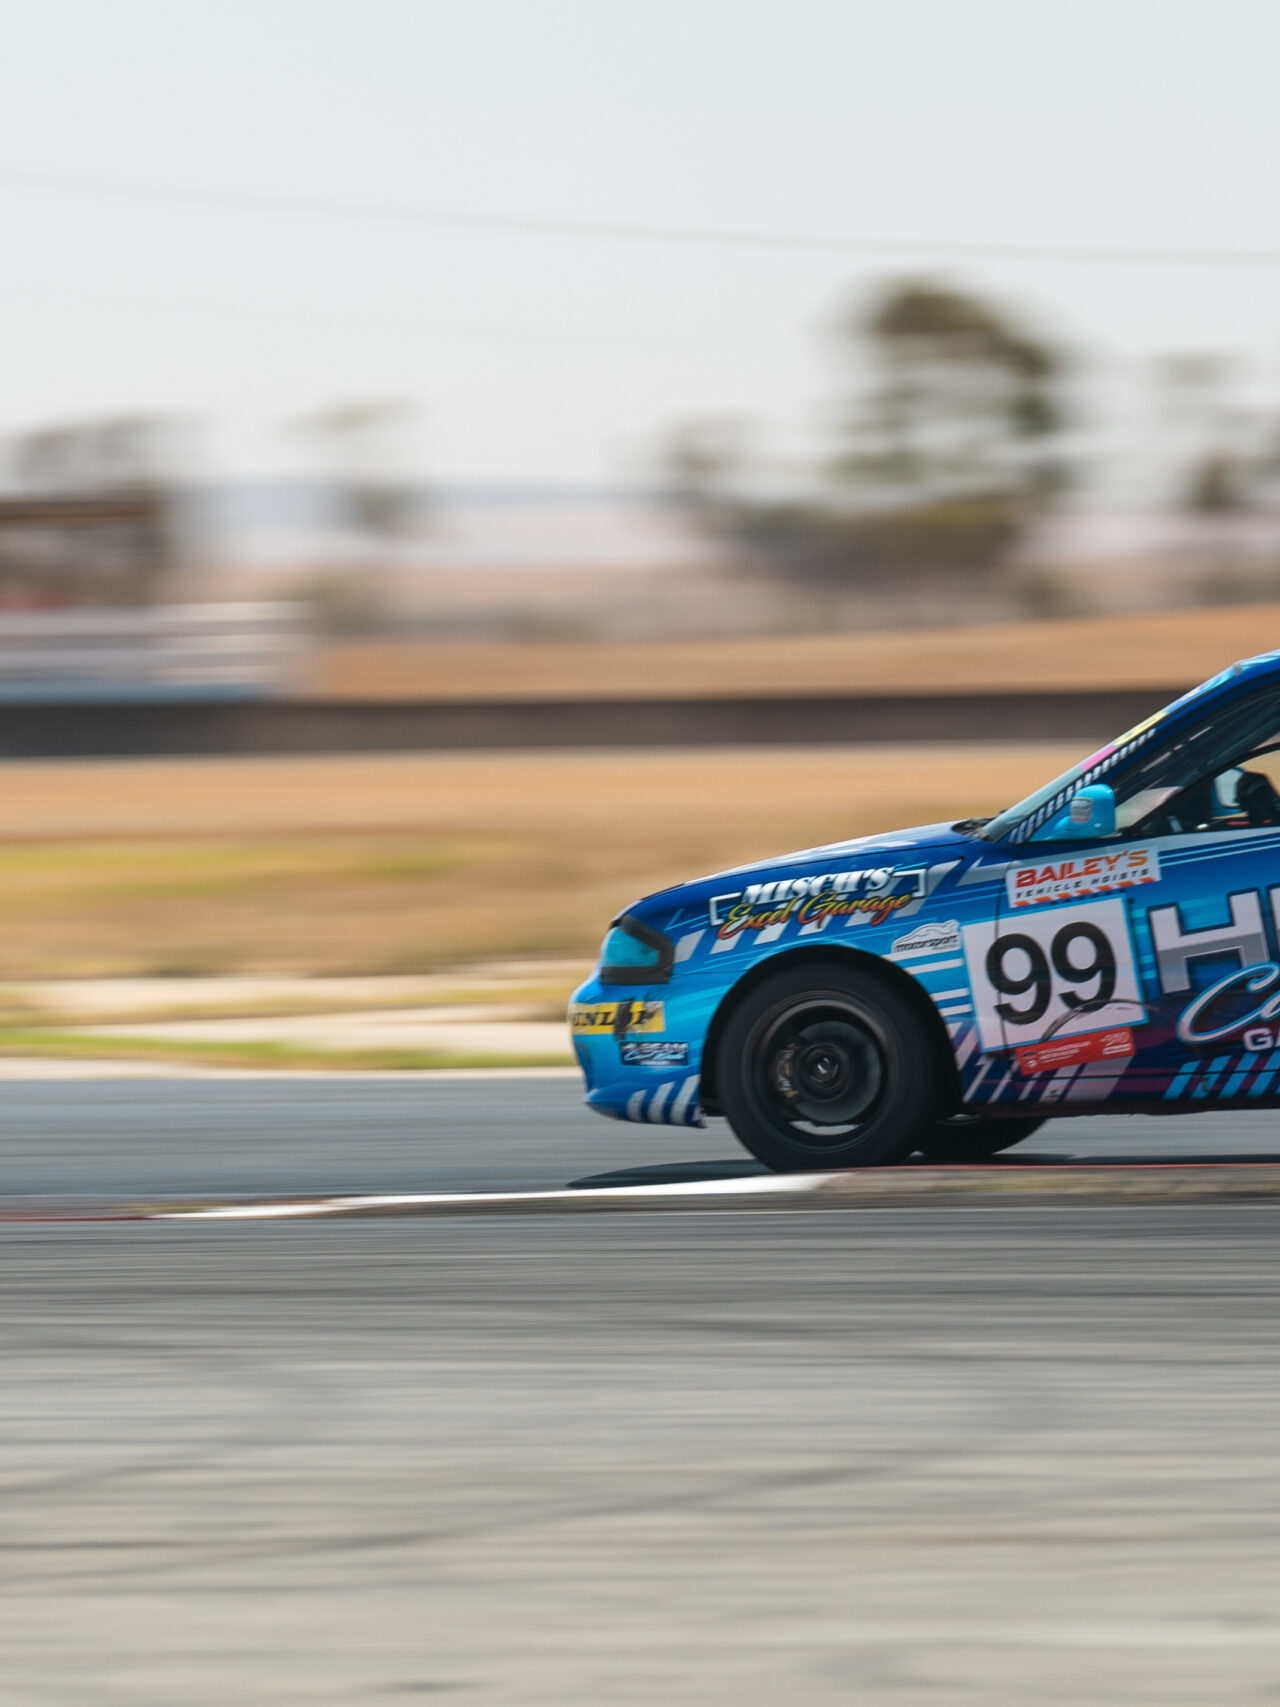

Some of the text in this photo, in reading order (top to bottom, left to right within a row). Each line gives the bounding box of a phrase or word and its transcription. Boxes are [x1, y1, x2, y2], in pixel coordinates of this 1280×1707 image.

[743, 866, 895, 905] MISCH'S
[1015, 868, 1150, 898] VEHICLE HOISTS
[1016, 849, 1149, 888] BAILEY'S
[717, 891, 912, 940] Excel Garage
[985, 921, 1117, 1025] 99
